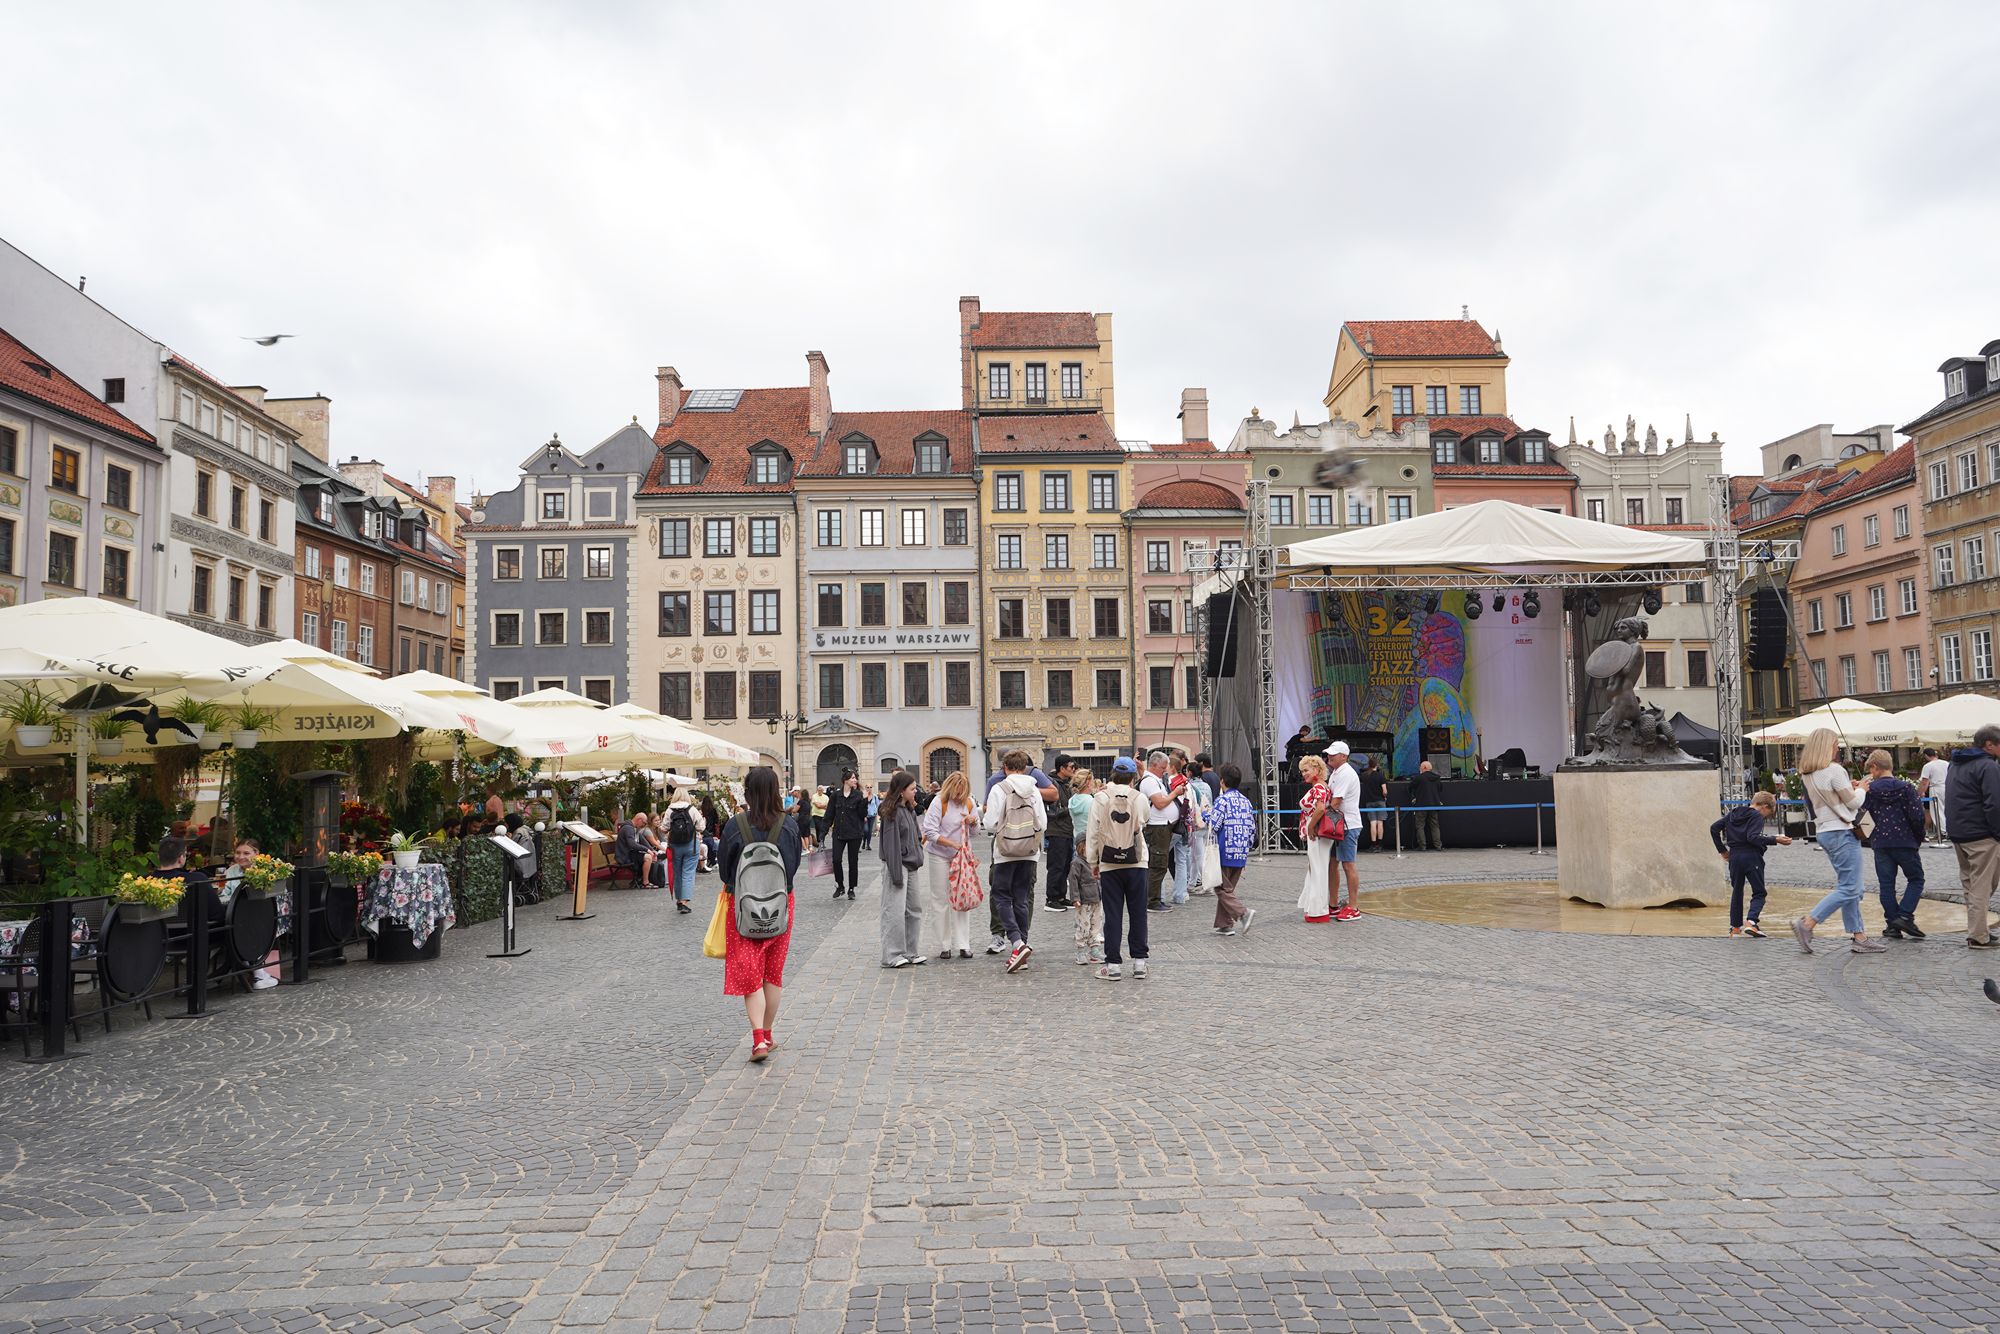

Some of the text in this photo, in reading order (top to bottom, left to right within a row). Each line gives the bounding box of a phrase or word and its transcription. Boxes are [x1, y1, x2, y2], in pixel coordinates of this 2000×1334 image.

[1368, 606, 1412, 635] 32
[832, 634, 970, 645] MUZEUM WARSZAWY
[1368, 642, 1412, 650] PLENEROWY
[1369, 650, 1413, 660] FESTIWAL
[1370, 660, 1414, 675] JAZZ
[1370, 676, 1415, 686] STAROWCE
